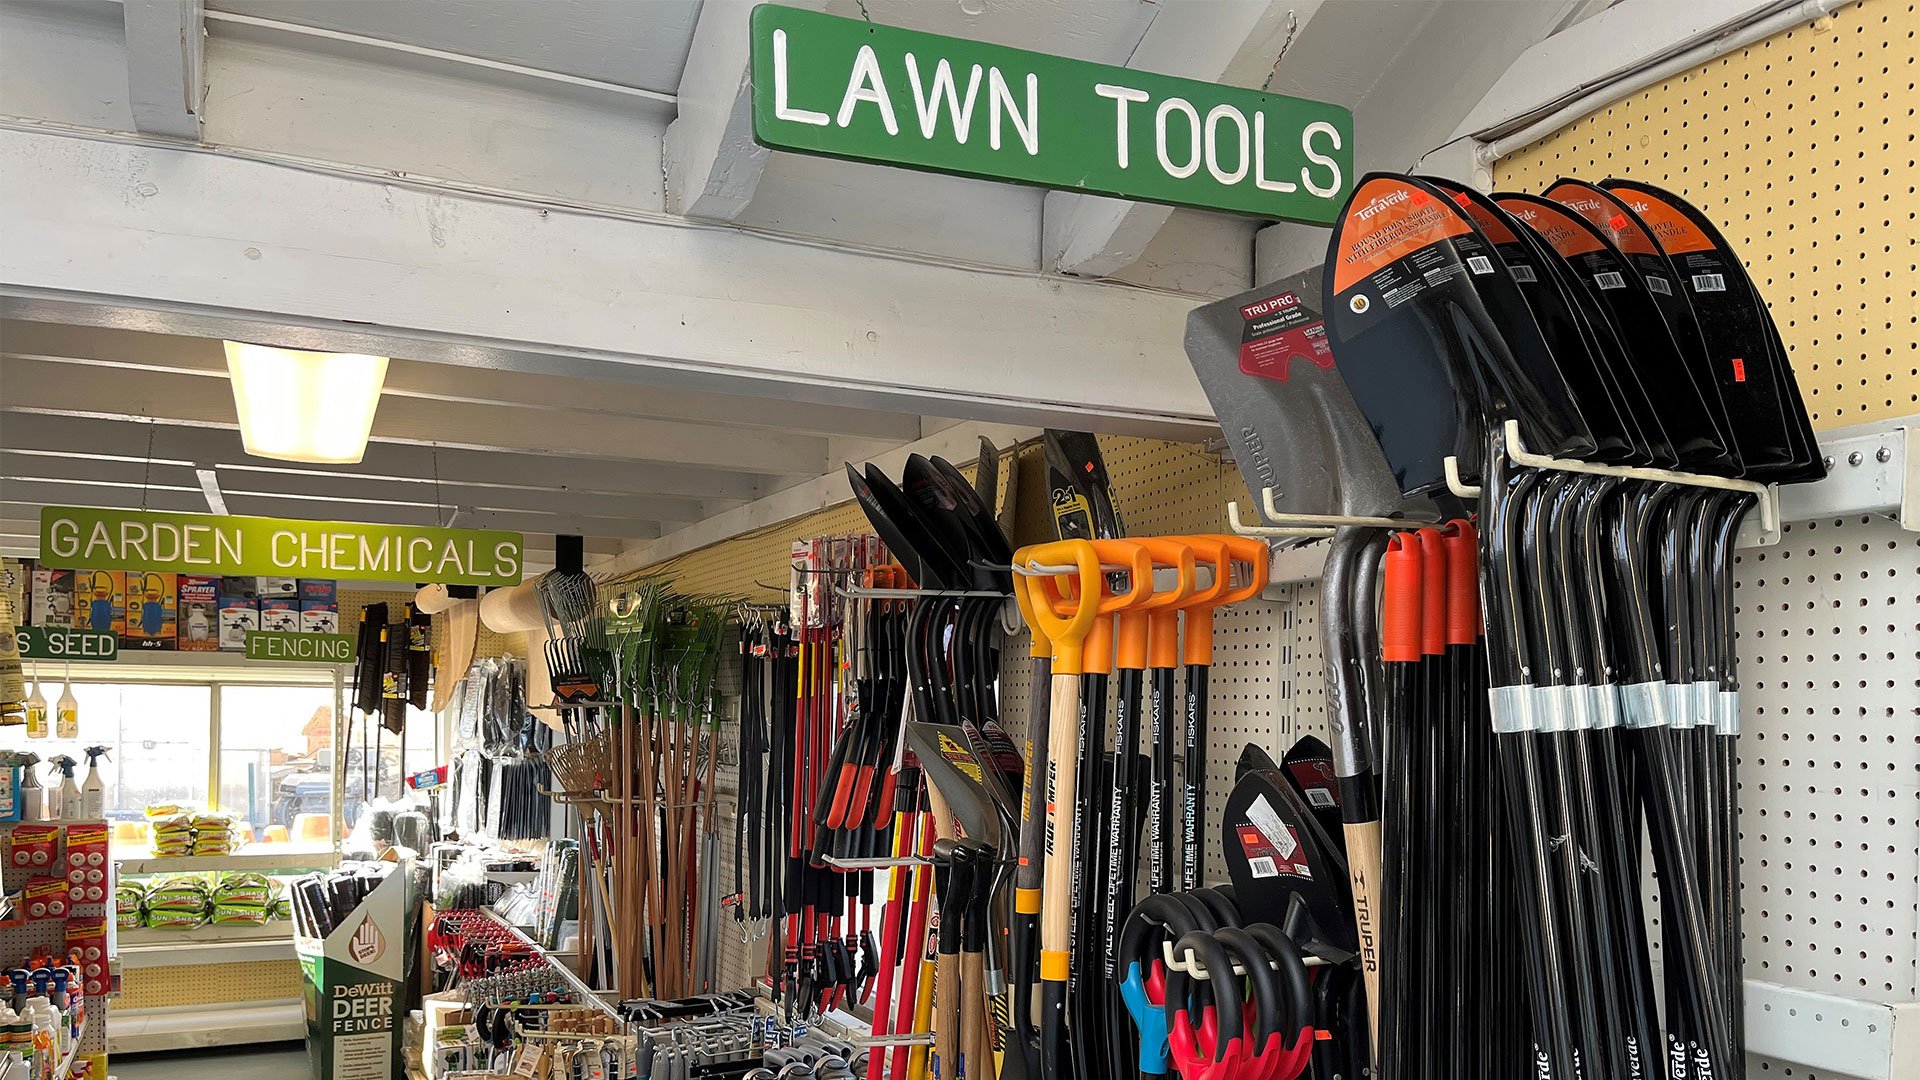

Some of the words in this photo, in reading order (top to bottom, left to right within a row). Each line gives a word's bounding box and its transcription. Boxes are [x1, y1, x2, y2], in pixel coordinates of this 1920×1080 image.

[772, 28, 1038, 156] LAWN
[1095, 82, 1342, 198] TOOLS
[1354, 189, 1410, 221] TerraVerde
[1345, 247, 1369, 265] WITH
[1370, 222, 1420, 254] FIBERGLASS
[1420, 210, 1448, 229] HANDLE
[1351, 230, 1382, 252] ROUND
[1382, 218, 1407, 237] POINT
[1408, 206, 1436, 223] SHOVEL
[1541, 224, 1566, 236] OVEL
[1650, 220, 1676, 232] OVEL
[1656, 227, 1688, 239] ANDLE
[1245, 303, 1269, 316] TRU
[1269, 295, 1294, 309] PRO
[1253, 316, 1285, 330] Professional
[1286, 311, 1302, 321] Grade
[49, 518, 243, 566] GARDEN
[271, 529, 519, 579] CHEMICALS
[181, 584, 216, 594] SPRAYER
[48, 632, 114, 656] SEED
[252, 636, 350, 659] FENCING
[1116, 698, 1125, 755] FISKARS
[1187, 692, 1196, 748] FISKARS
[1110, 787, 1122, 849] WARRANTY
[1152, 780, 1161, 840] WARRANTY
[1185, 784, 1196, 843] WARRANTY
[1045, 822, 1055, 857] TRUE
[1108, 849, 1118, 896] LIFETIME
[1151, 840, 1160, 888] LIFETIME
[1184, 843, 1194, 890] LIFETIME
[1106, 900, 1115, 932] STEEL
[358, 945, 374, 954] STOPS
[1105, 933, 1114, 956] ALL
[1357, 896, 1377, 972] TRUPER
[334, 981, 394, 998] DeWitt
[333, 998, 393, 1019] DEER
[333, 1016, 393, 1033] FENCE
